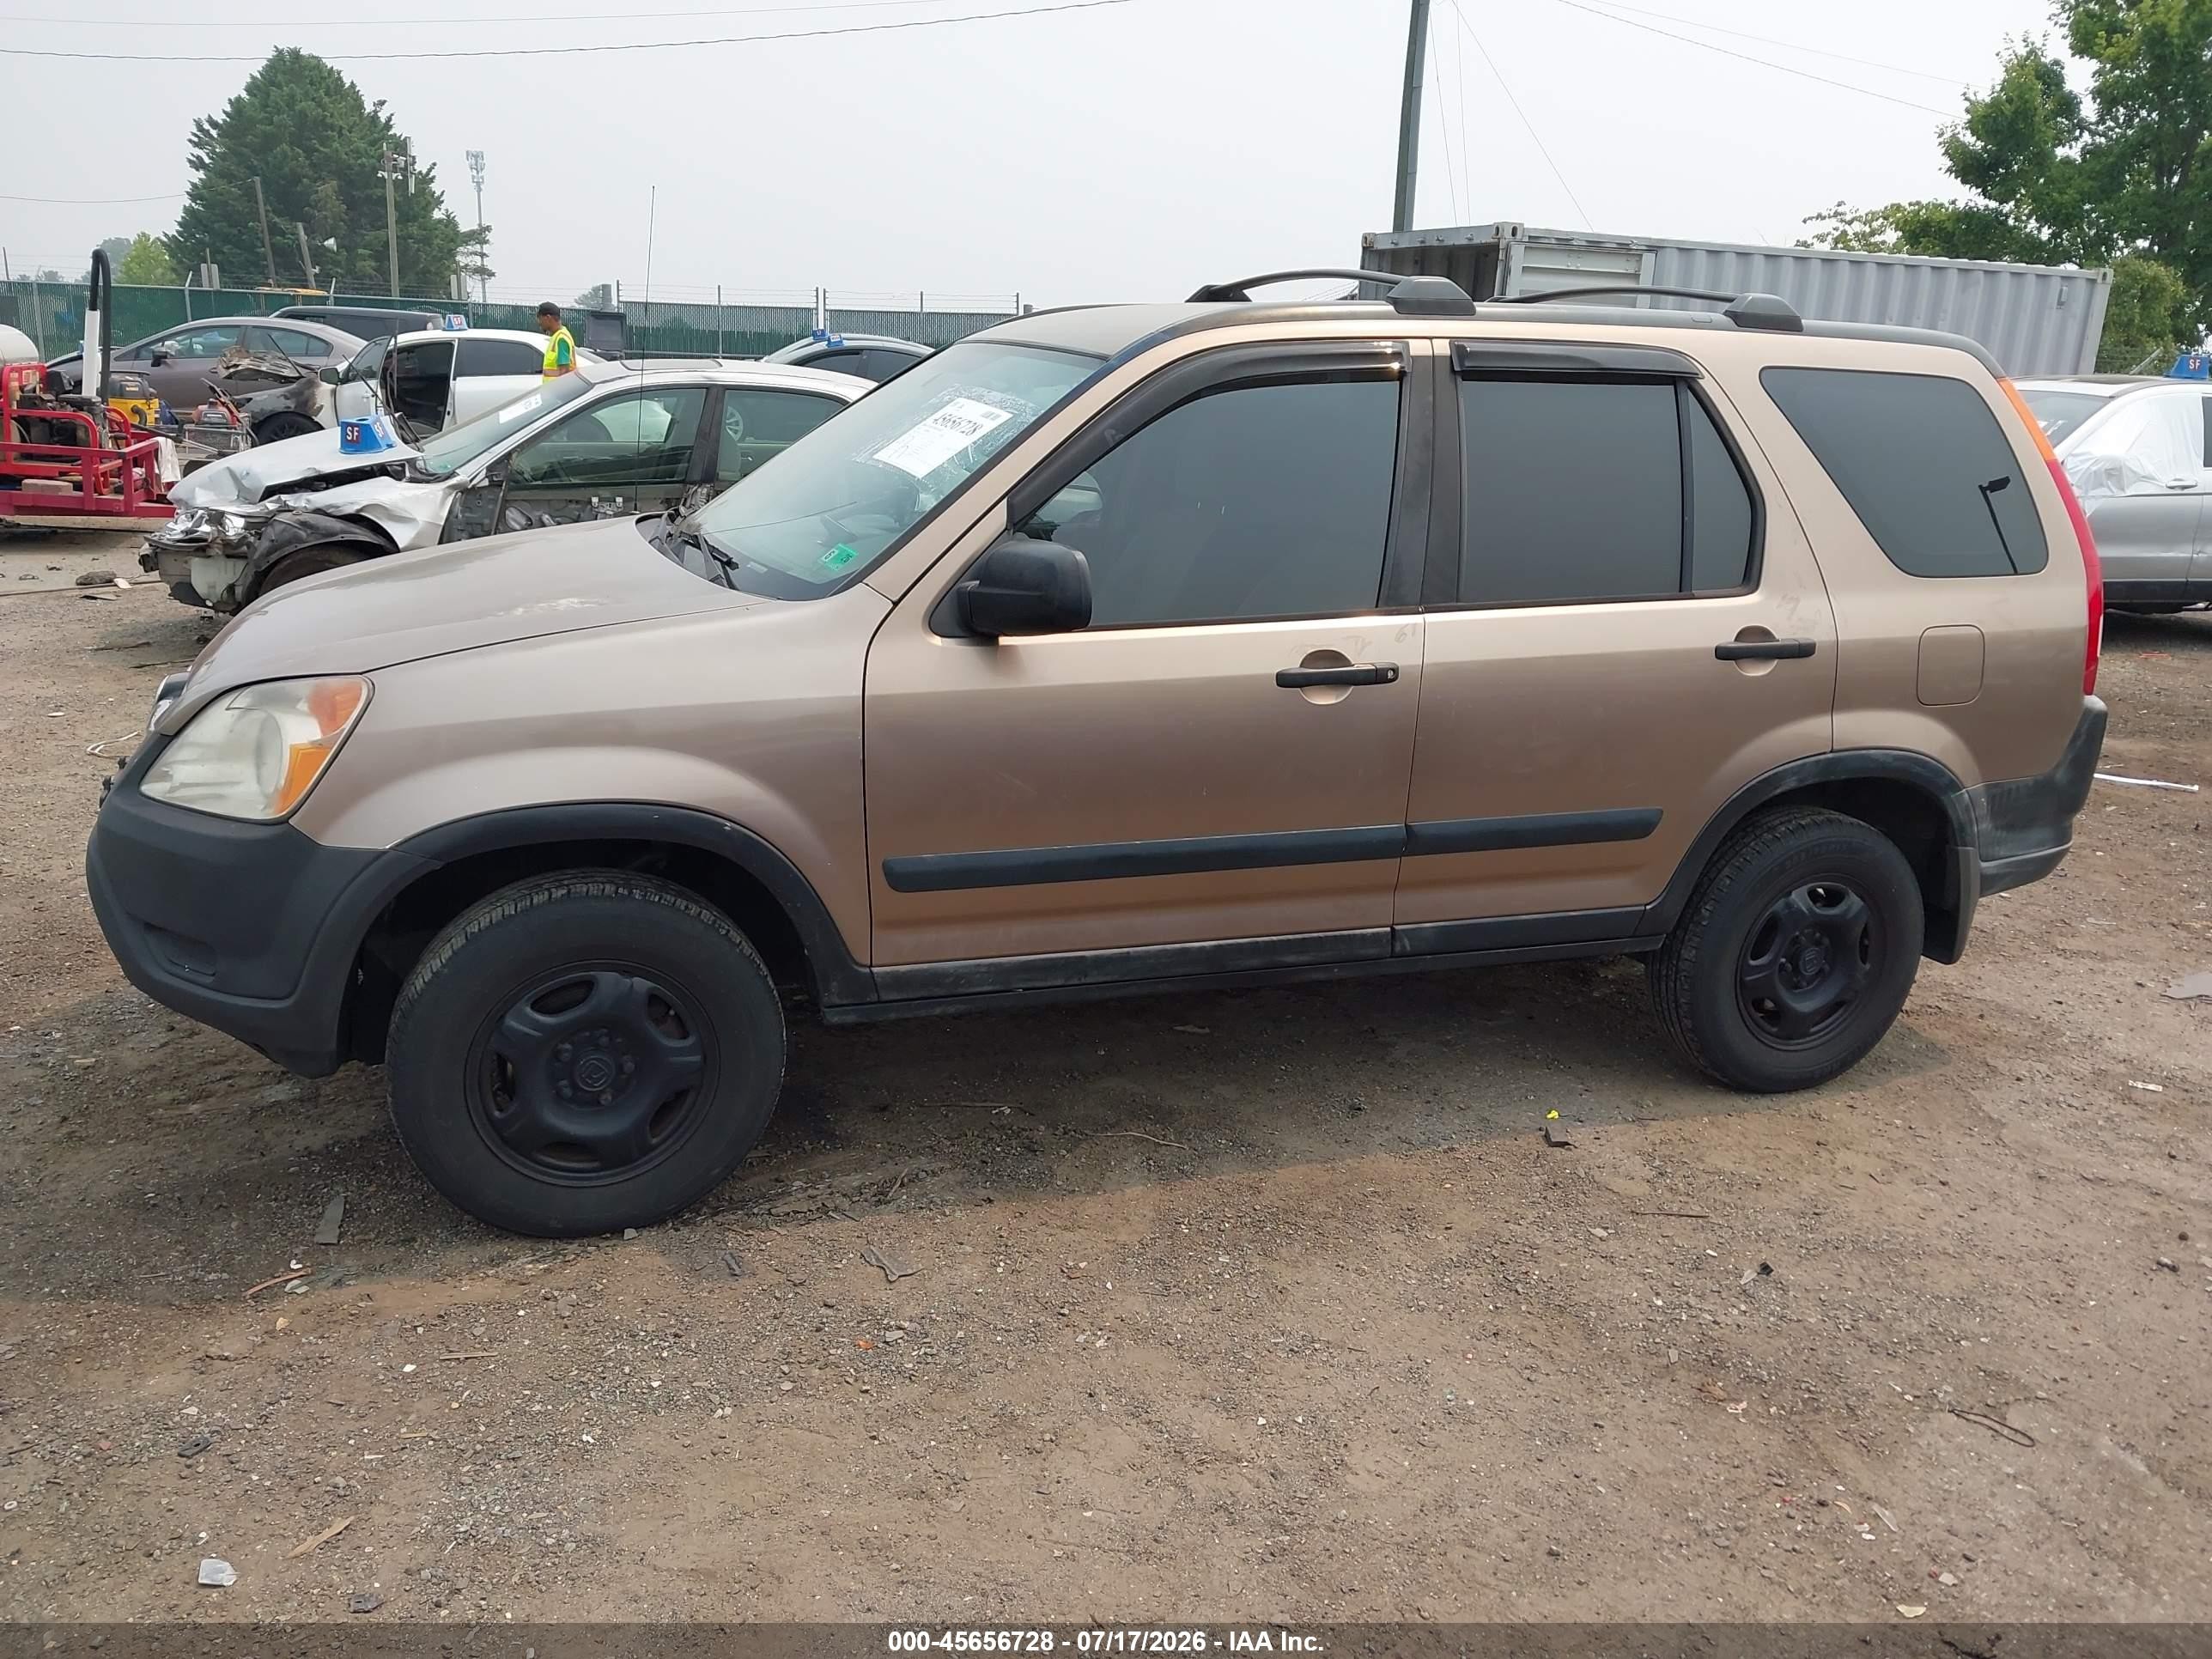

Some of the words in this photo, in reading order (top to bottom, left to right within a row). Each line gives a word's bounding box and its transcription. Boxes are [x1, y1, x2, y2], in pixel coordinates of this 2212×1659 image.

[2189, 359, 2201, 370] SF
[933, 412, 983, 436] 45656728
[346, 426, 360, 441] SF
